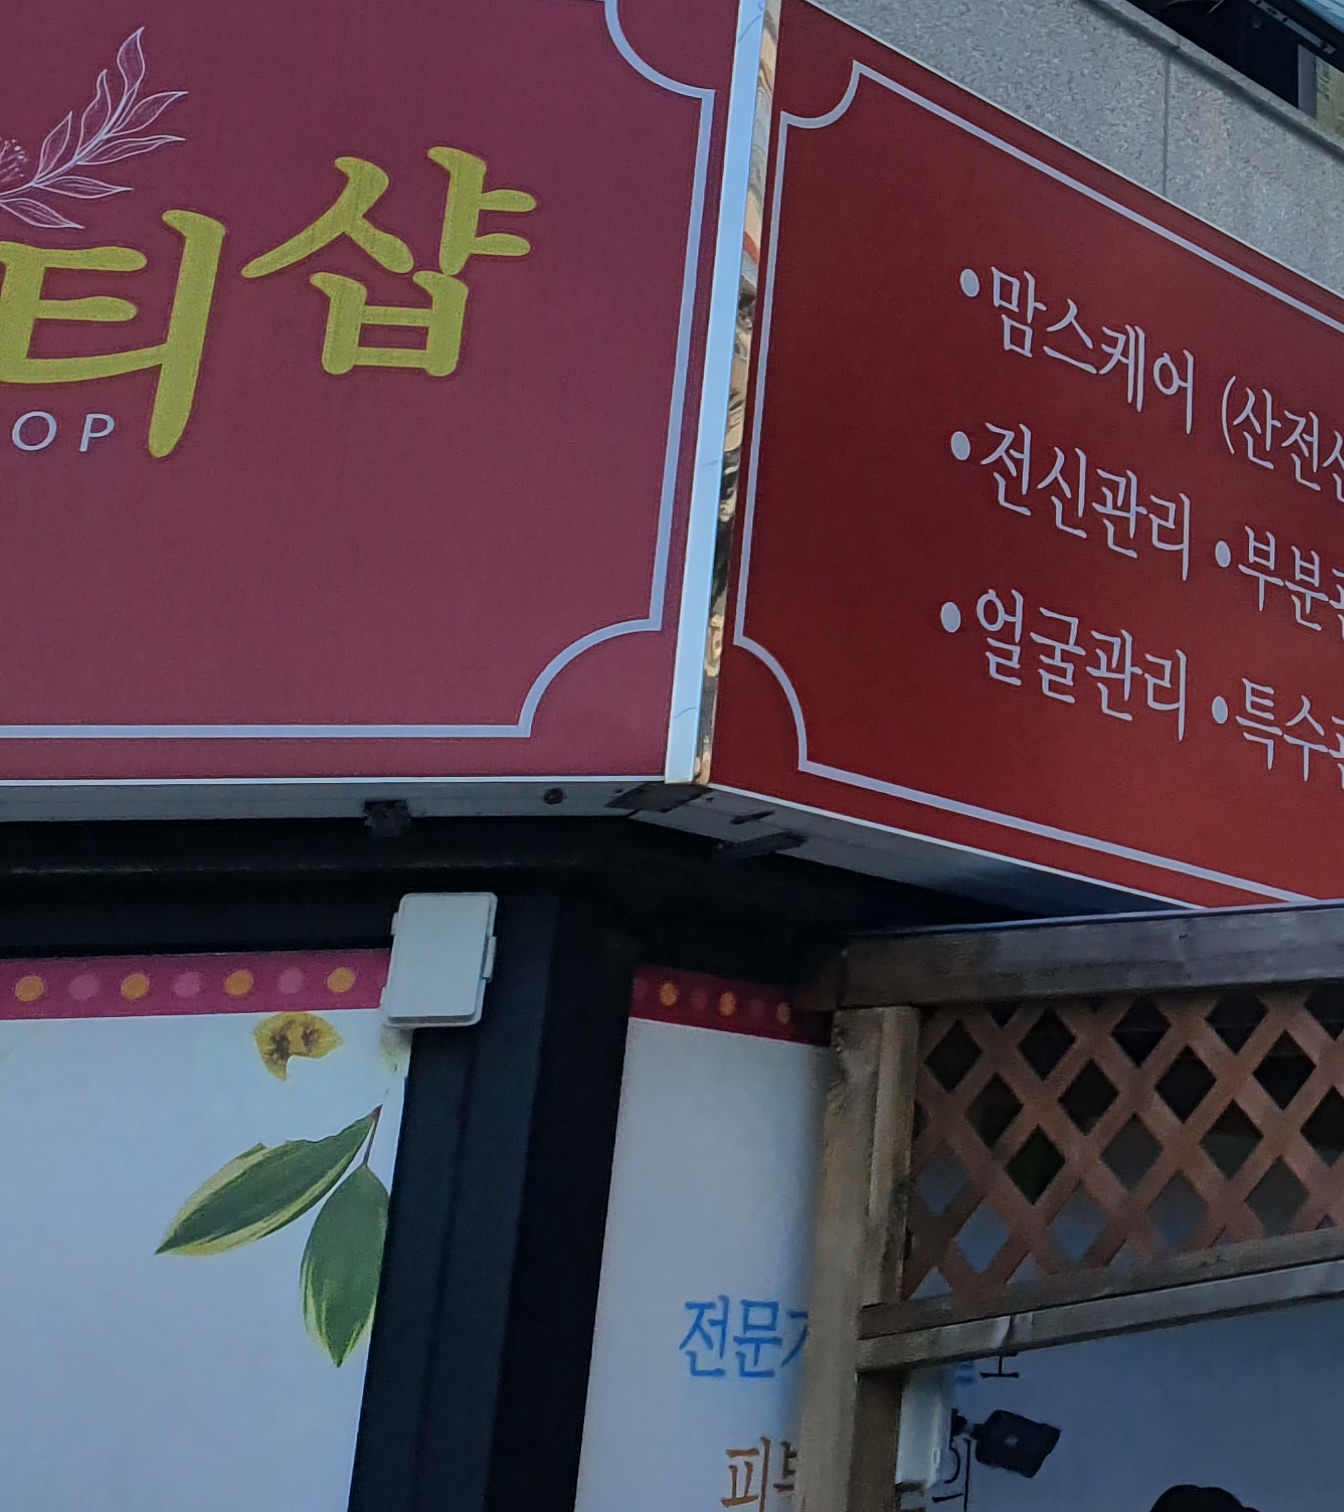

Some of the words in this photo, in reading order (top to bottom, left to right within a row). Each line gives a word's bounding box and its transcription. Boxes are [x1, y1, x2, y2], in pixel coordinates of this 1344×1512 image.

[0, 146, 537, 459] 티샵
[991, 266, 1194, 435] 맘스케어
[980, 422, 1191, 581] 전신관리
[976, 588, 1188, 742] 얼굴관리
